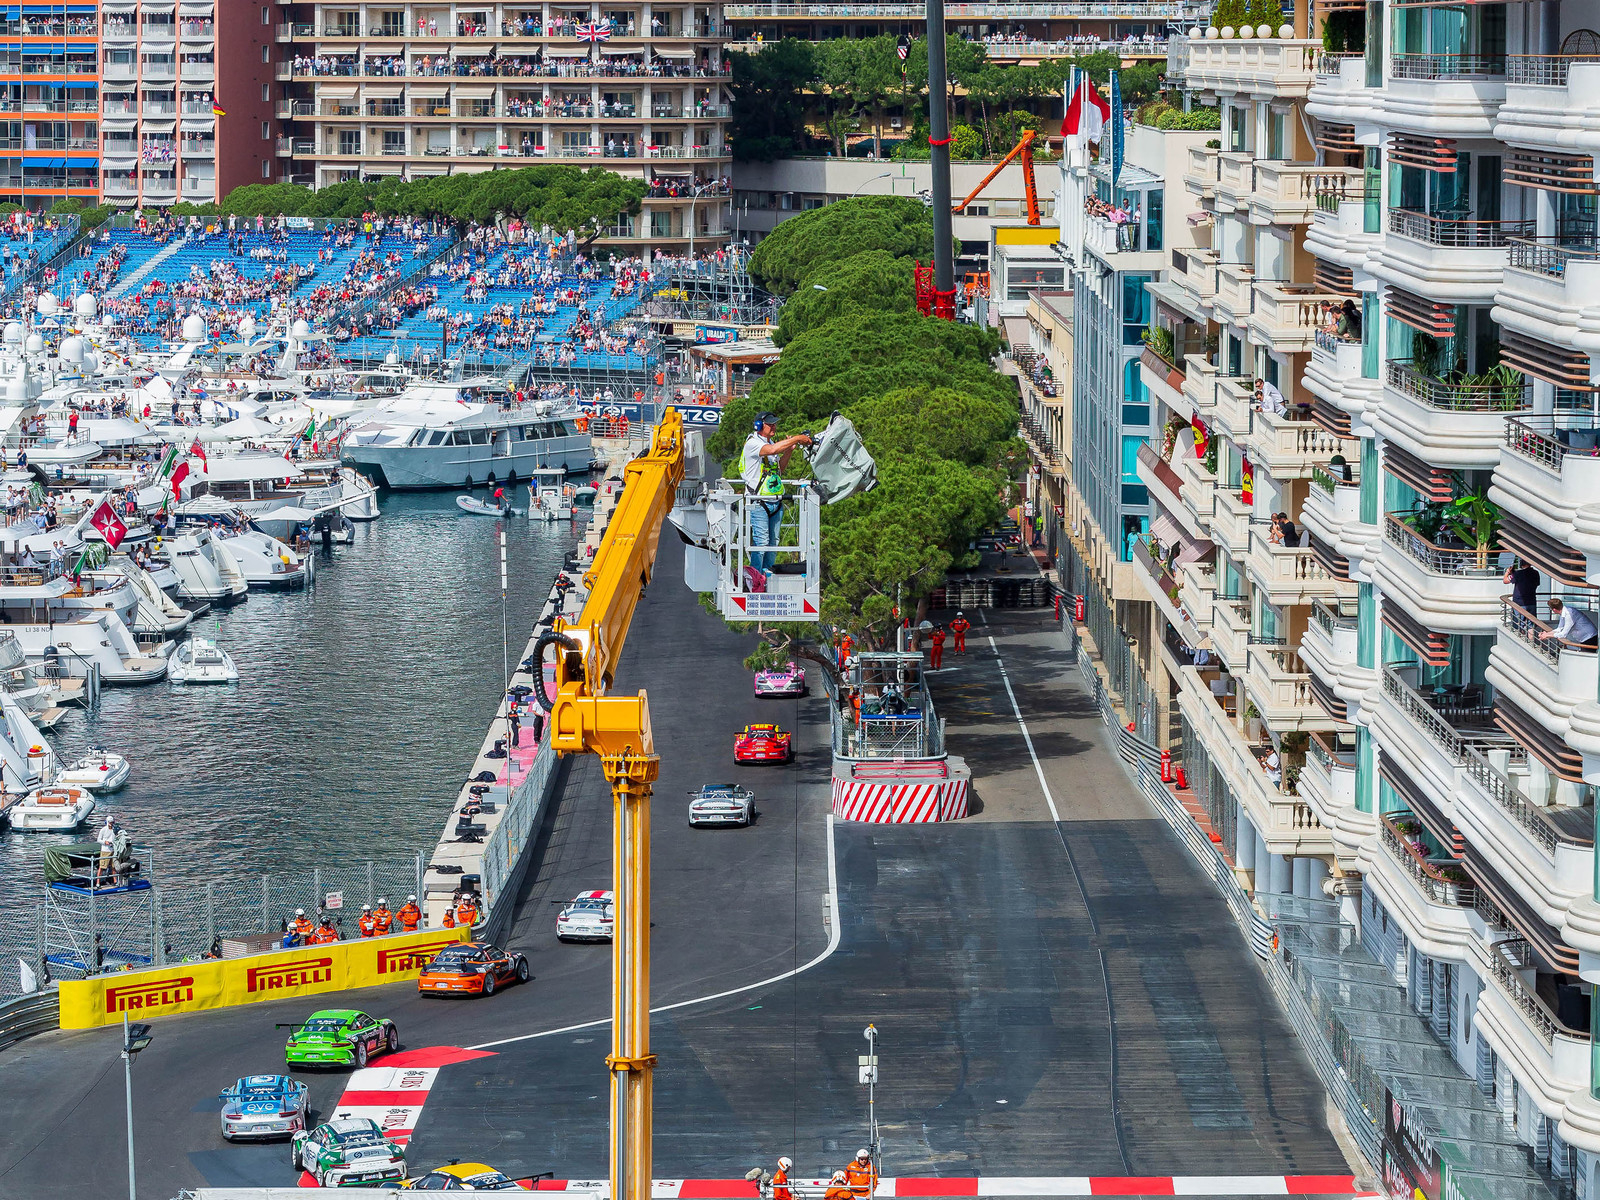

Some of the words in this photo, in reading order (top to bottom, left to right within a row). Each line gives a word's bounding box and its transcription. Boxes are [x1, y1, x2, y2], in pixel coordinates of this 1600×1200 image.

[247, 957, 333, 993] PIRELLI
[106, 976, 194, 1013] PIRELLI
[247, 1102, 274, 1111] eve
